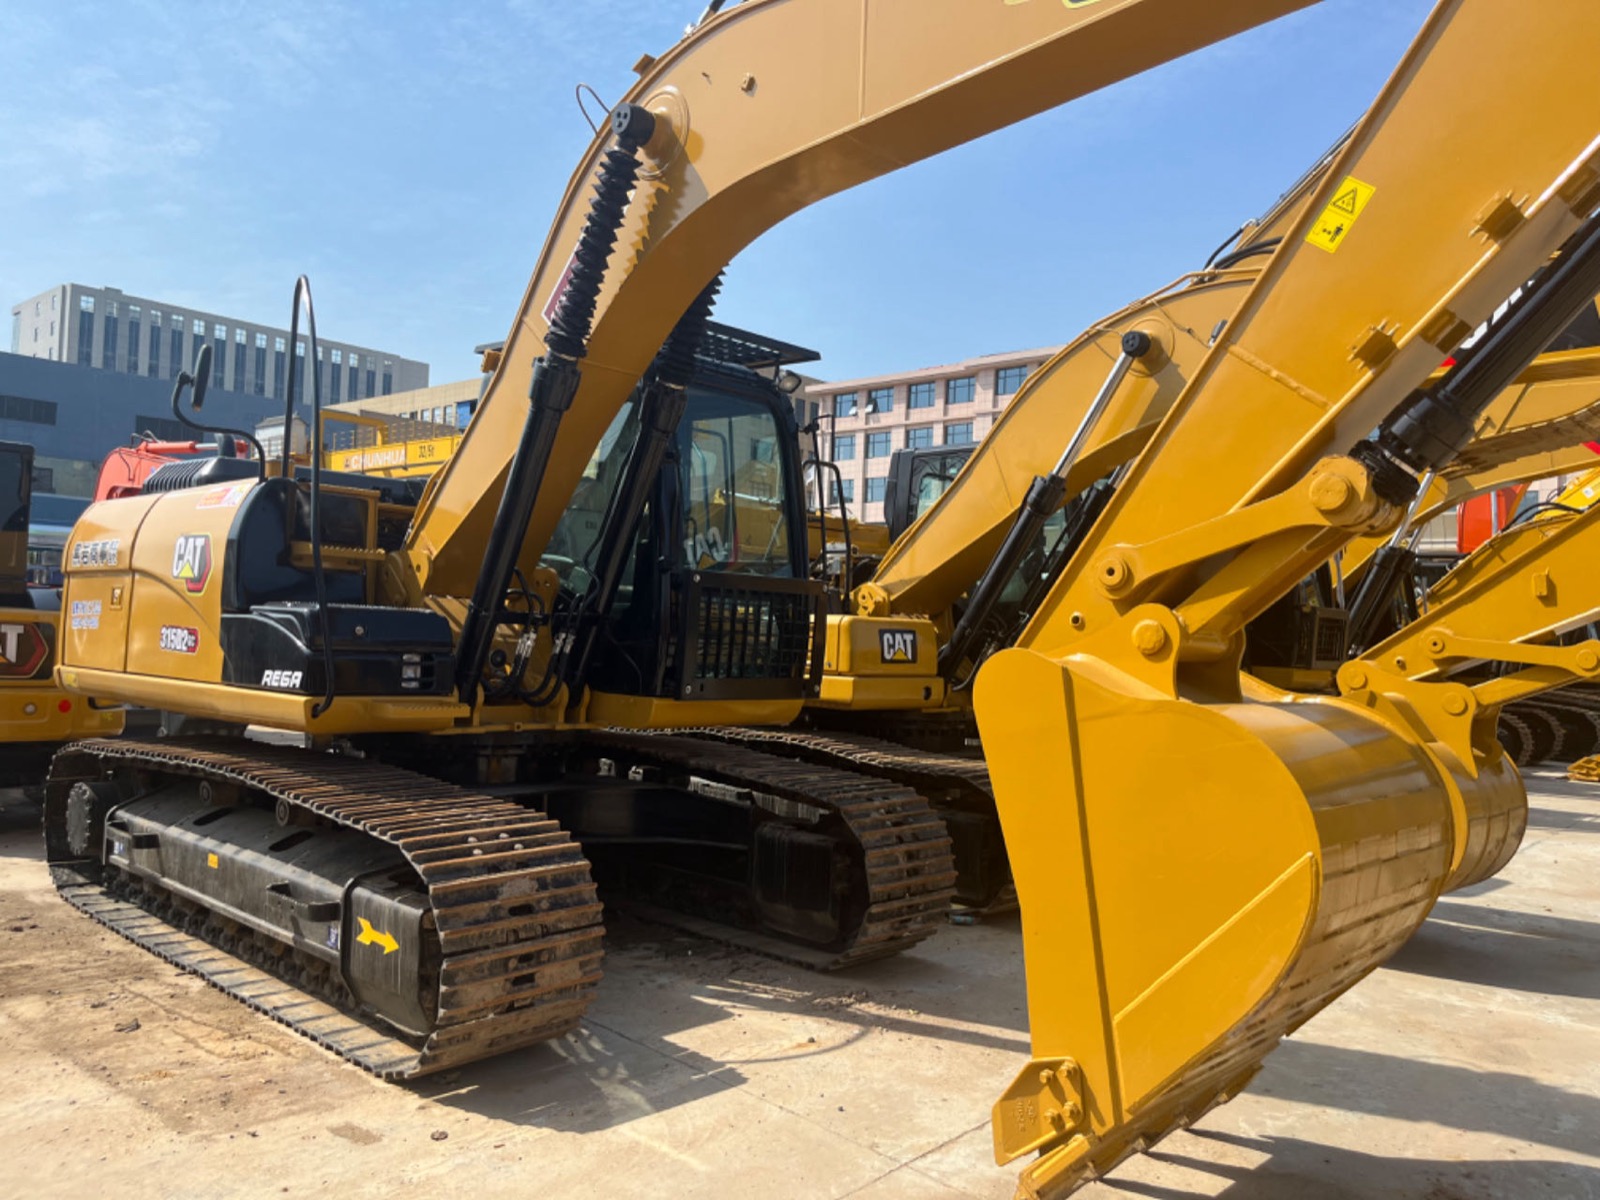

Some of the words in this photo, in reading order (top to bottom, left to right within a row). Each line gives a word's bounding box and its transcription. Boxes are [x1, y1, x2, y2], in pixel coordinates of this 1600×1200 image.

[350, 448, 405, 469] CHUNHUA
[173, 536, 206, 578] CAT
[0, 624, 24, 664] T
[883, 633, 913, 660] CAT
[261, 669, 303, 689] REGA
